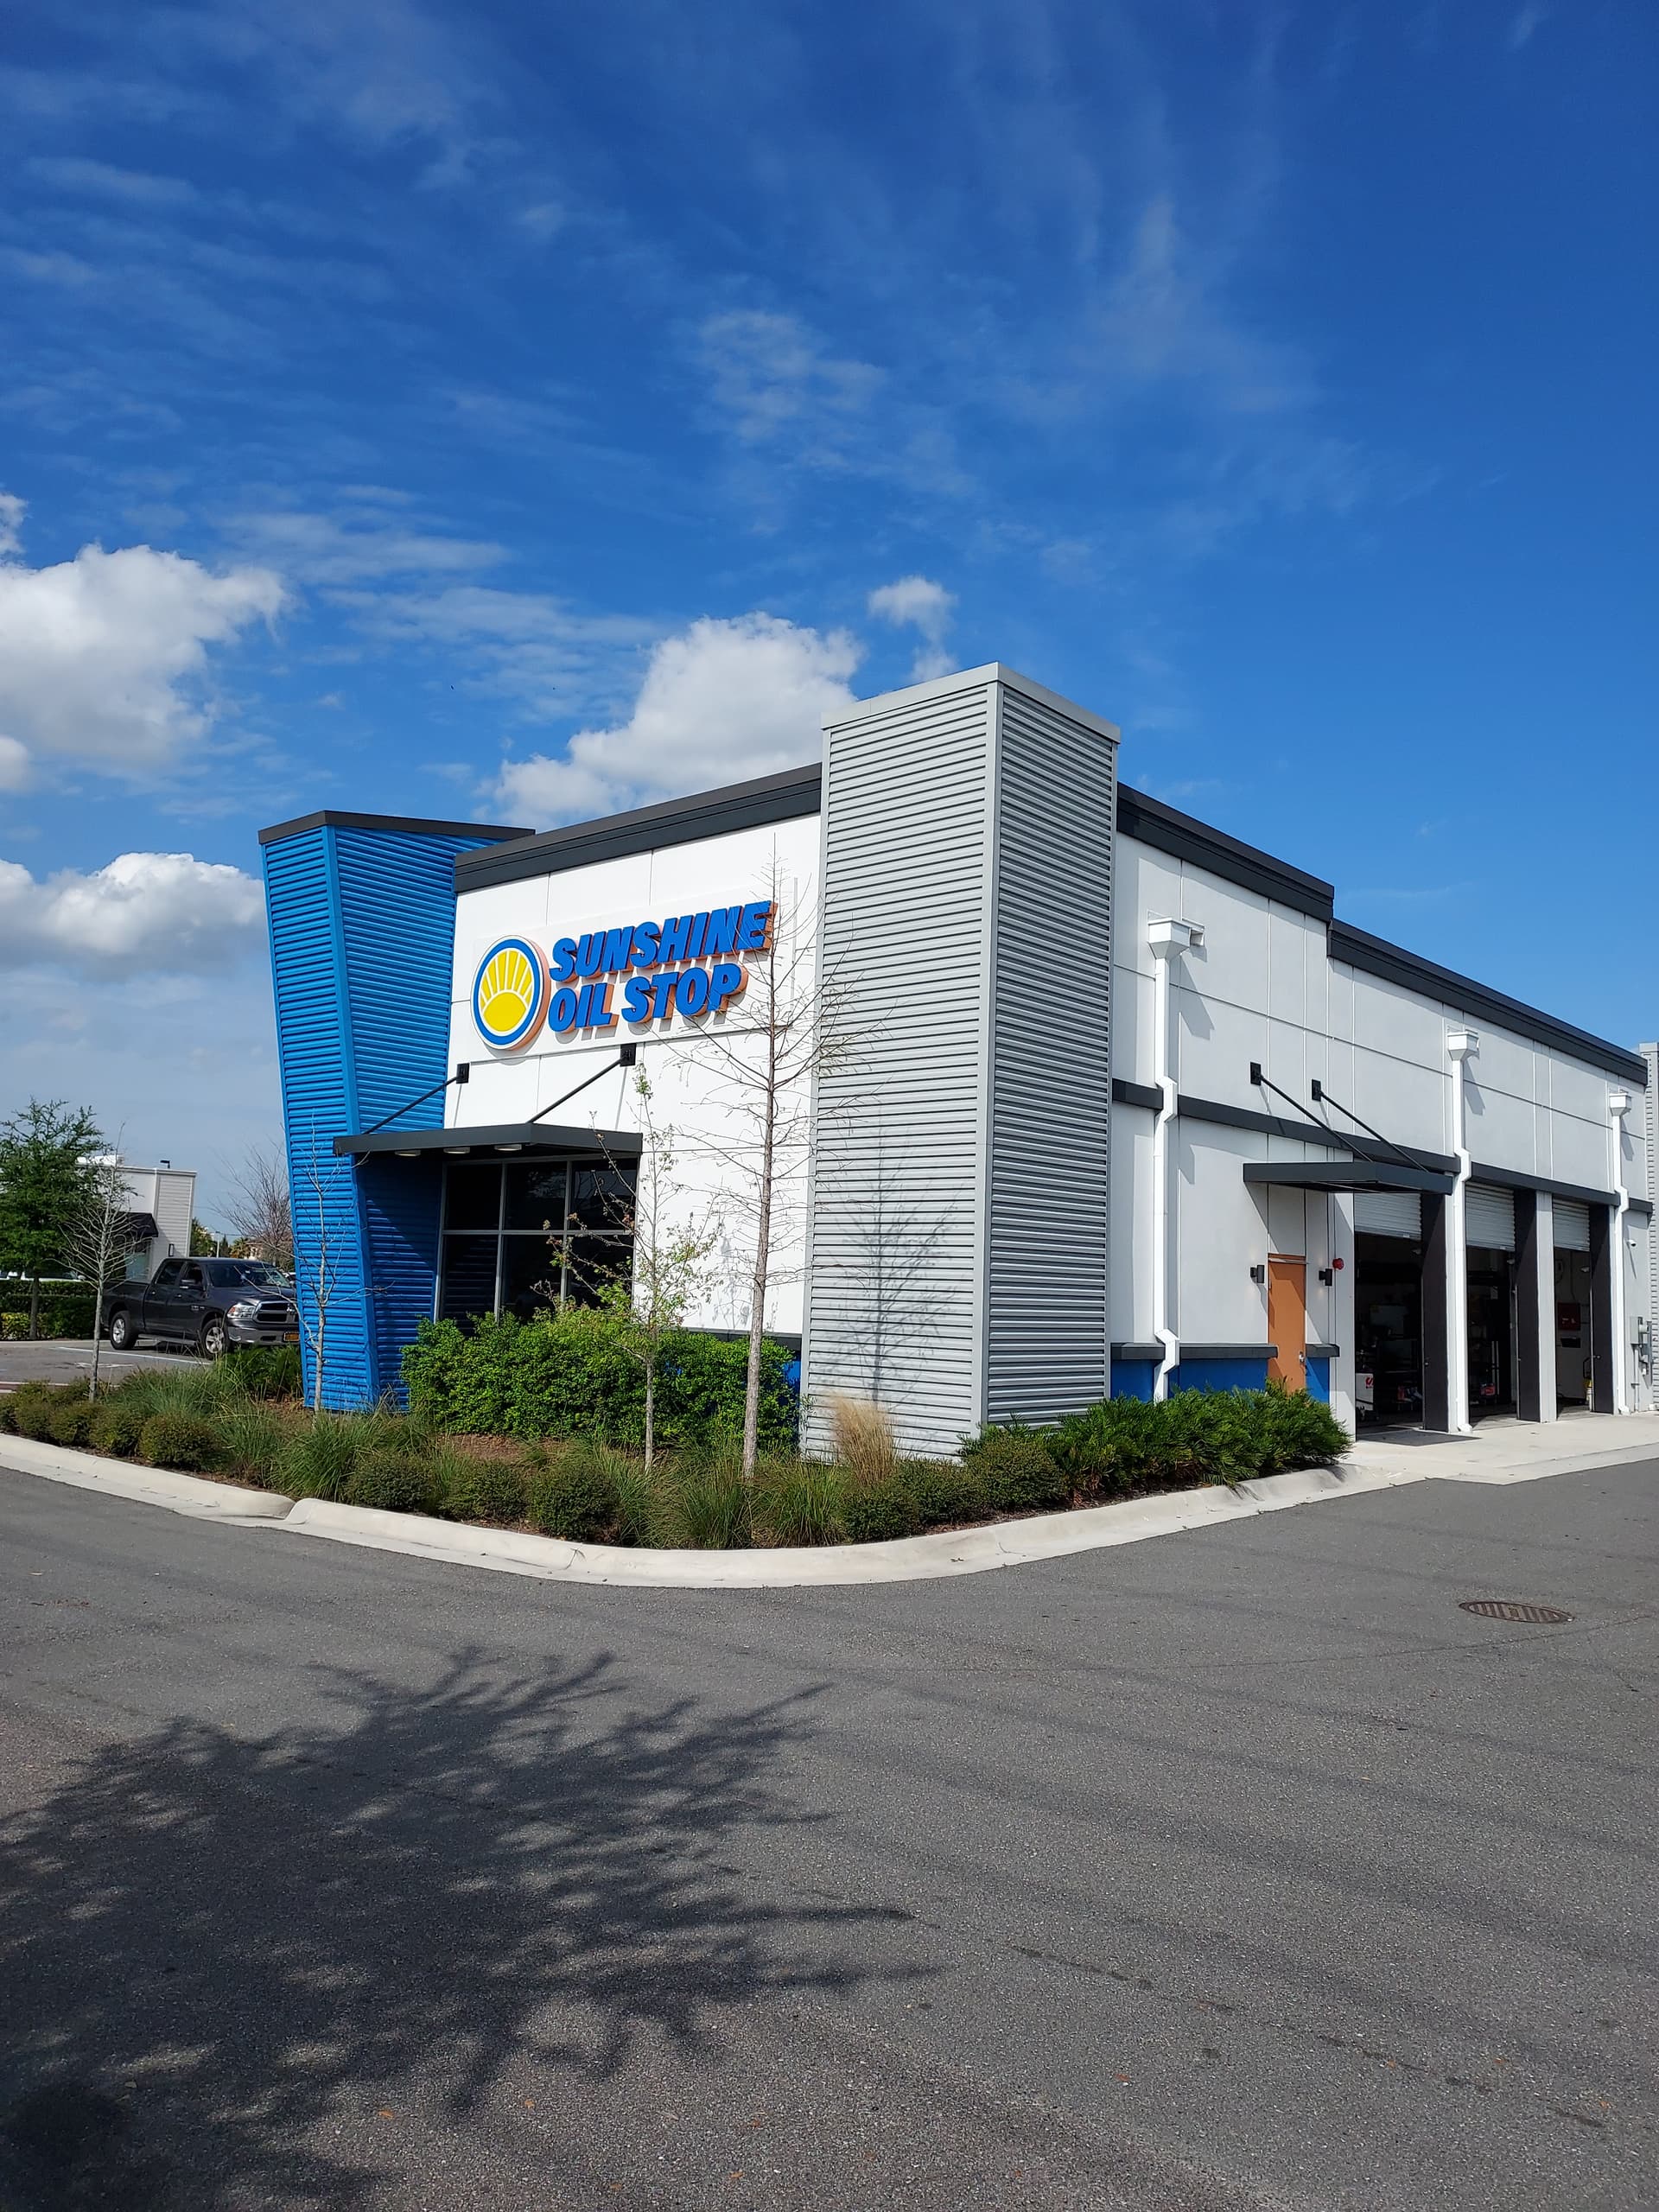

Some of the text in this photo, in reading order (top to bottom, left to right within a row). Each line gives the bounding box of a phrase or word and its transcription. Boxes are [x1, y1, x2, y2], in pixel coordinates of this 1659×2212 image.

[549, 900, 776, 982] SUNSHINE
[549, 963, 746, 1033] OIL STOP
